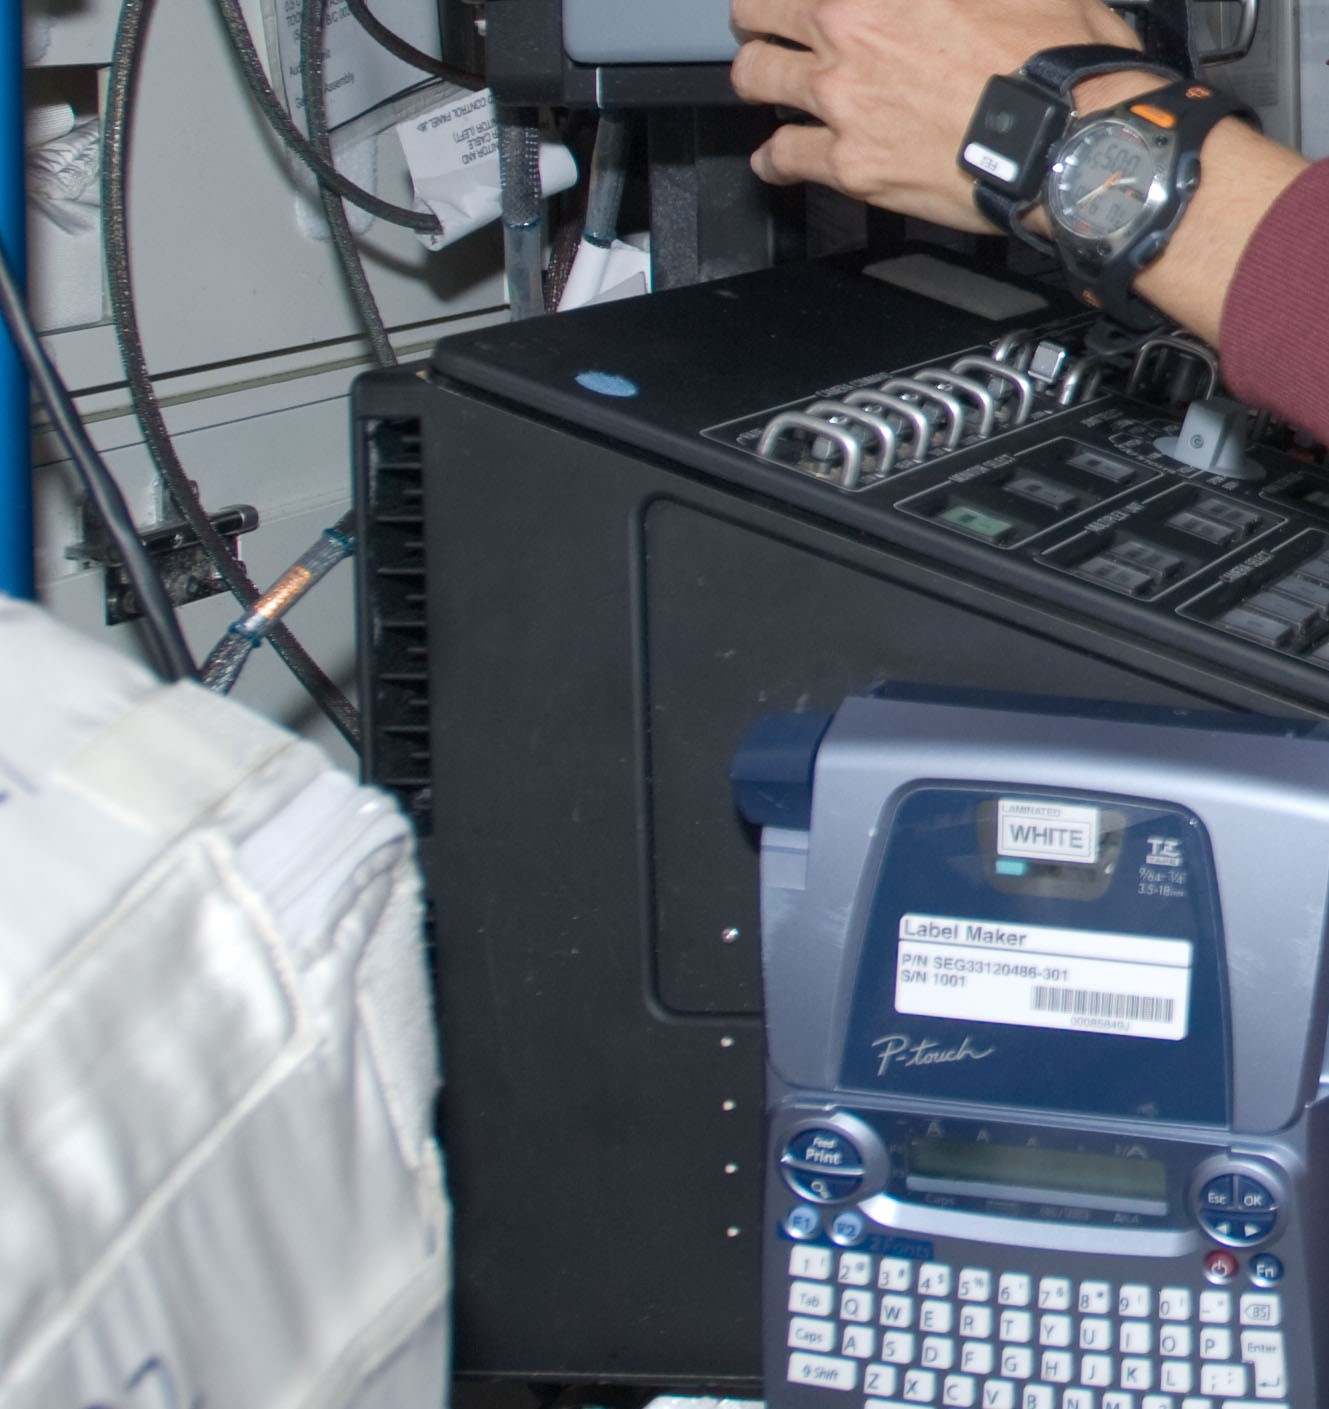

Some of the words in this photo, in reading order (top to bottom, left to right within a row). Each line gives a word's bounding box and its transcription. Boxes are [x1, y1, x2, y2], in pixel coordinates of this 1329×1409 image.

[452, 96, 487, 118] CONTROL
[428, 111, 452, 129] PANEL
[467, 132, 491, 150] CABLE
[1001, 804, 1061, 818] LAMINATED
[1009, 824, 1084, 850] WHITE
[904, 920, 958, 939] Label
[966, 925, 1027, 947] Maker
[901, 953, 928, 968] P/N
[901, 970, 927, 984] S/N
[934, 973, 966, 988] 1001
[872, 1034, 995, 1077] P-touch
[806, 1148, 842, 1165] Print
[1208, 1192, 1226, 1205] Esc
[1243, 1194, 1262, 1206] OK
[793, 1215, 811, 1230] F1
[1256, 1264, 1274, 1278] Fn
[839, 1265, 849, 1280] 2
[881, 1272, 890, 1286] 3
[920, 1278, 931, 1291] 4
[960, 1282, 969, 1296] 5
[1001, 1286, 1010, 1302] 6
[1041, 1292, 1050, 1306] 7
[1080, 1296, 1089, 1309] 8
[1120, 1297, 1129, 1311] 9
[1160, 1301, 1170, 1315] 0
[799, 1293, 821, 1308] Tab
[844, 1298, 859, 1316] Q
[885, 1305, 902, 1322] W
[924, 1310, 934, 1327] E
[963, 1315, 974, 1332] R
[1003, 1319, 1014, 1336] T
[1043, 1325, 1054, 1340] Y
[1083, 1330, 1094, 1345] U
[1205, 1338, 1216, 1352] P
[795, 1327, 824, 1344] Caps
[844, 1335, 857, 1352] A
[886, 1341, 895, 1358] S
[924, 1346, 938, 1363] D
[964, 1351, 974, 1367] F
[1004, 1355, 1017, 1372] G
[1046, 1361, 1058, 1376] H
[1087, 1365, 1095, 1380] J
[1127, 1367, 1138, 1383] K
[1167, 1371, 1176, 1386] L
[1247, 1342, 1277, 1355] Enter
[813, 1365, 840, 1381] Shift
[867, 1372, 880, 1389] Z
[906, 1378, 918, 1395] X
[946, 1384, 959, 1401] C
[985, 1389, 999, 1405] V
